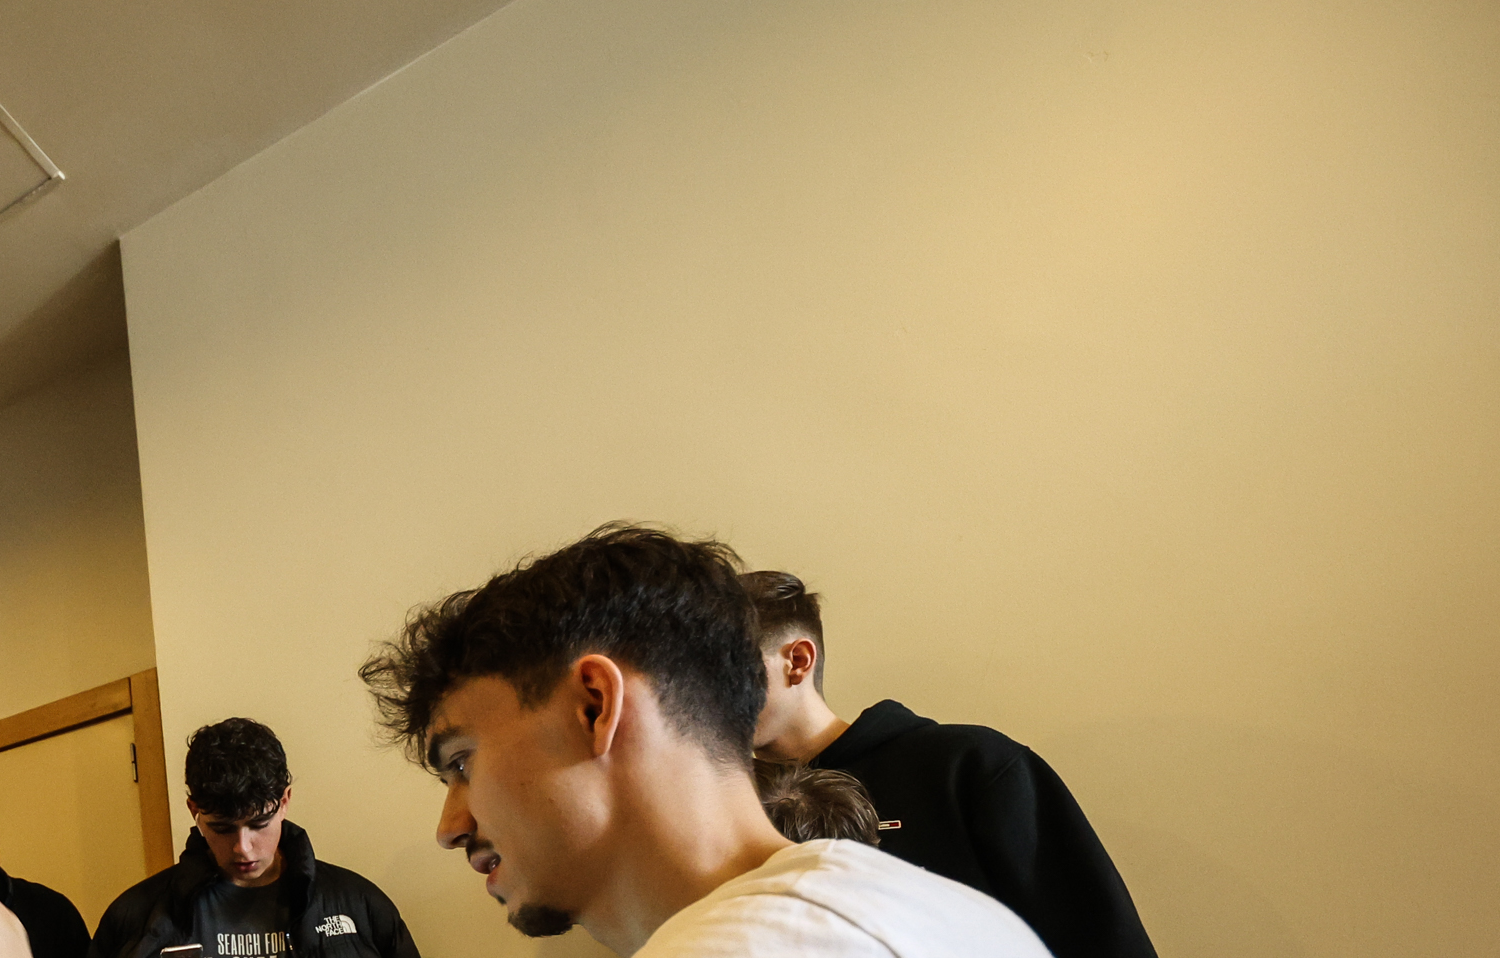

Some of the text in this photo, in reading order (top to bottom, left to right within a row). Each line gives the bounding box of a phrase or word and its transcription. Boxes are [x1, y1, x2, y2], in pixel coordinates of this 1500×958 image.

[324, 915, 340, 924] THE
[315, 921, 343, 934] NORTH
[326, 928, 344, 937] FACE
[217, 932, 286, 956] SEARCH FOR
